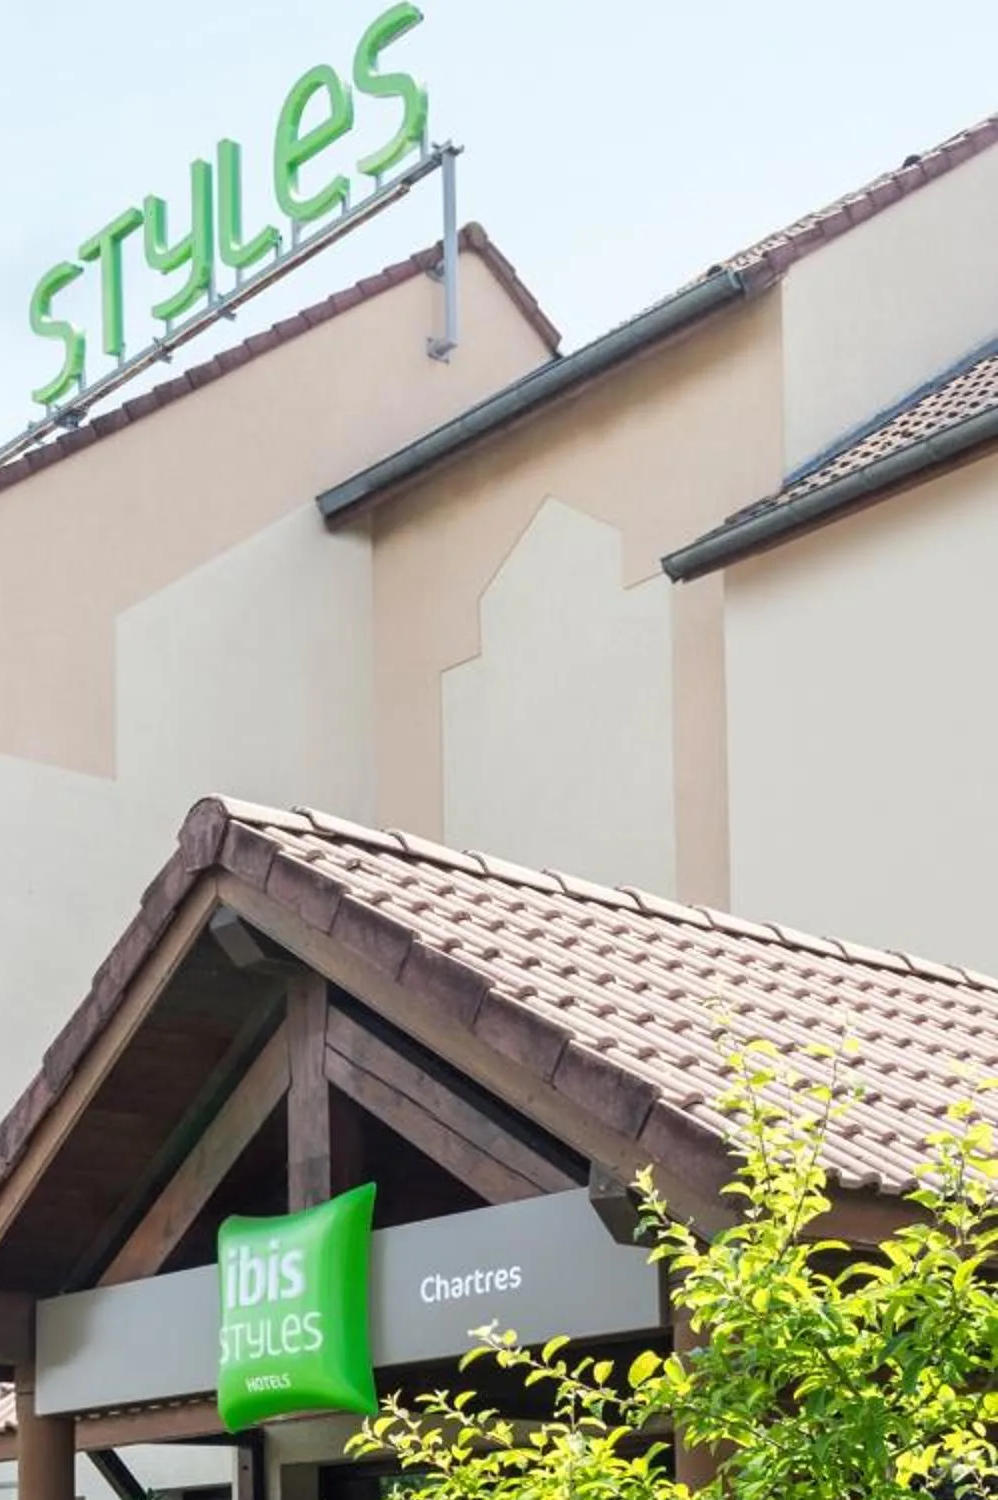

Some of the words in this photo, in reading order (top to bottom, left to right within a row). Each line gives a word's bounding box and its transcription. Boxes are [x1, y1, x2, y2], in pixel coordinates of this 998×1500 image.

[226, 1239, 306, 1309] ibis
[420, 1265, 522, 1302] Chartres
[245, 1373, 291, 1393] HOTELS
